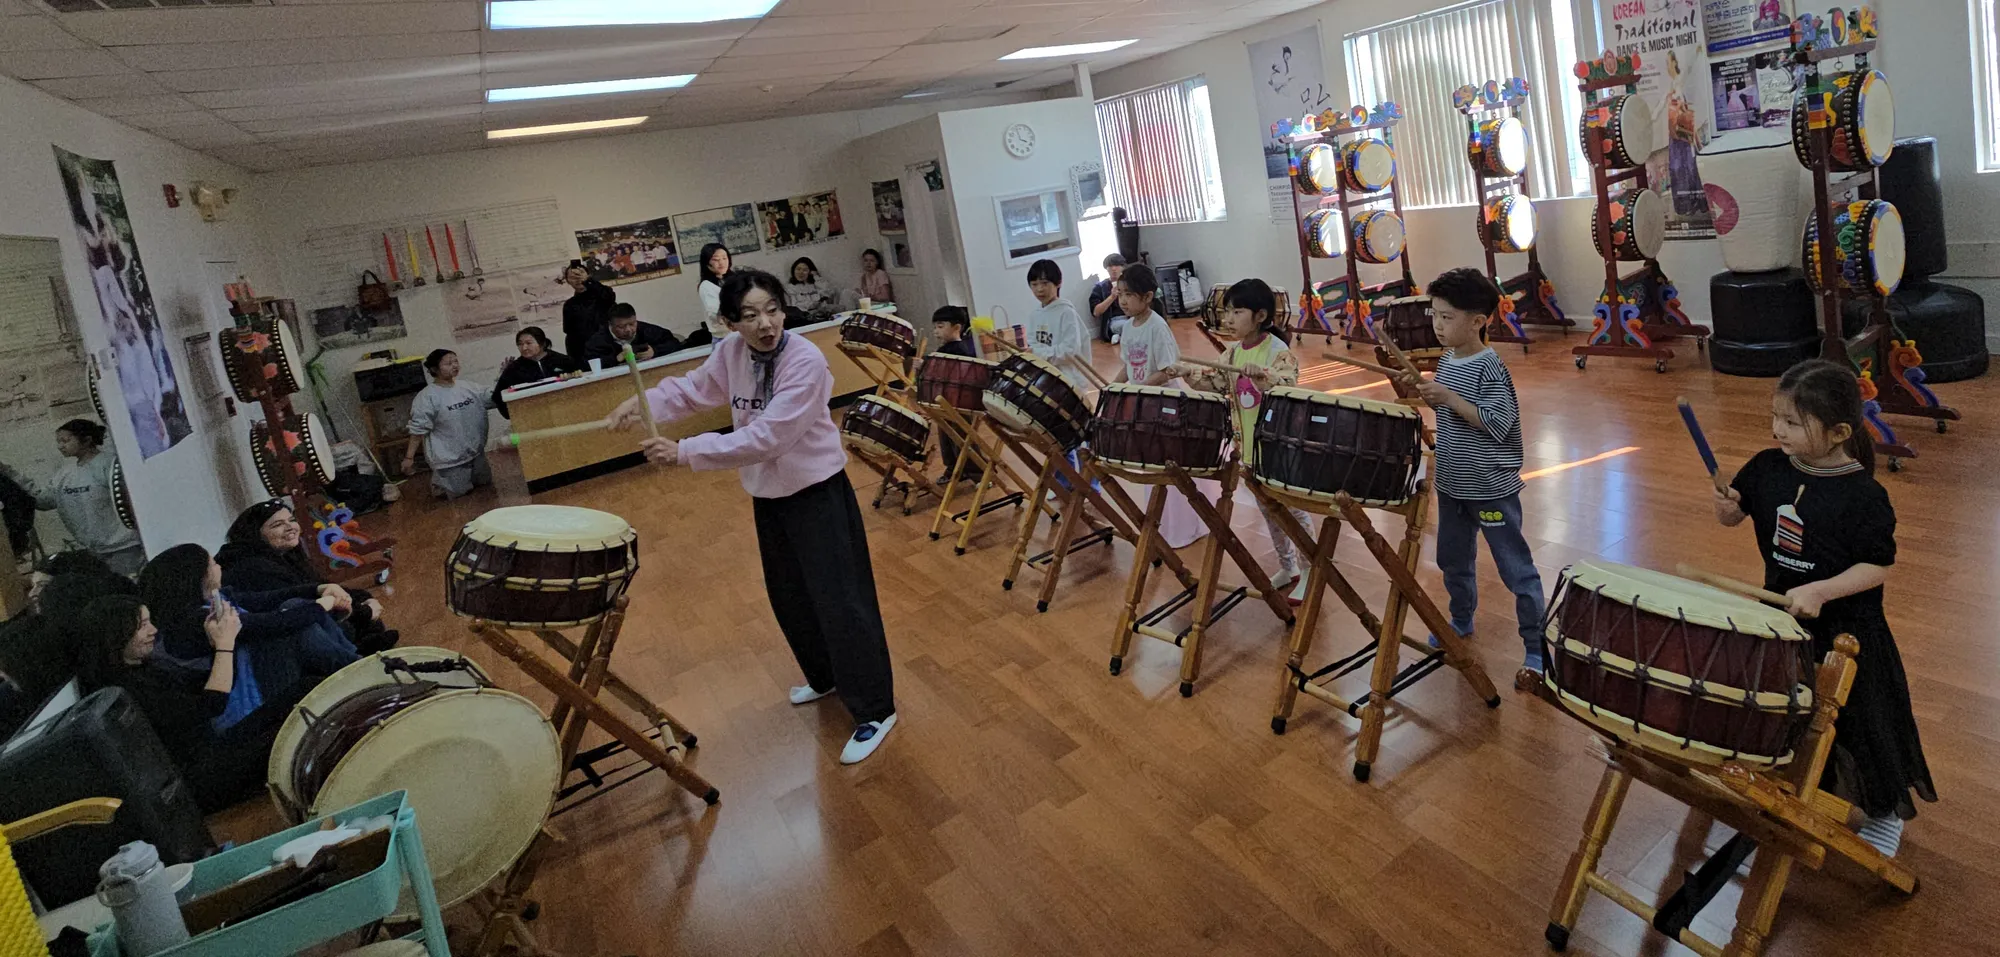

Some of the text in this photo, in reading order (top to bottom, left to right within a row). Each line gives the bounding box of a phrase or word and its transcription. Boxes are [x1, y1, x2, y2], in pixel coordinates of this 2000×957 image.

[1613, 0, 1645, 20] KOREAN
[1615, 9, 1696, 42] Traditional
[1617, 42, 1639, 57] DANCE
[1641, 41, 1647, 53] &
[1649, 36, 1674, 52] MUSIC
[1676, 31, 1697, 47] NIGHT
